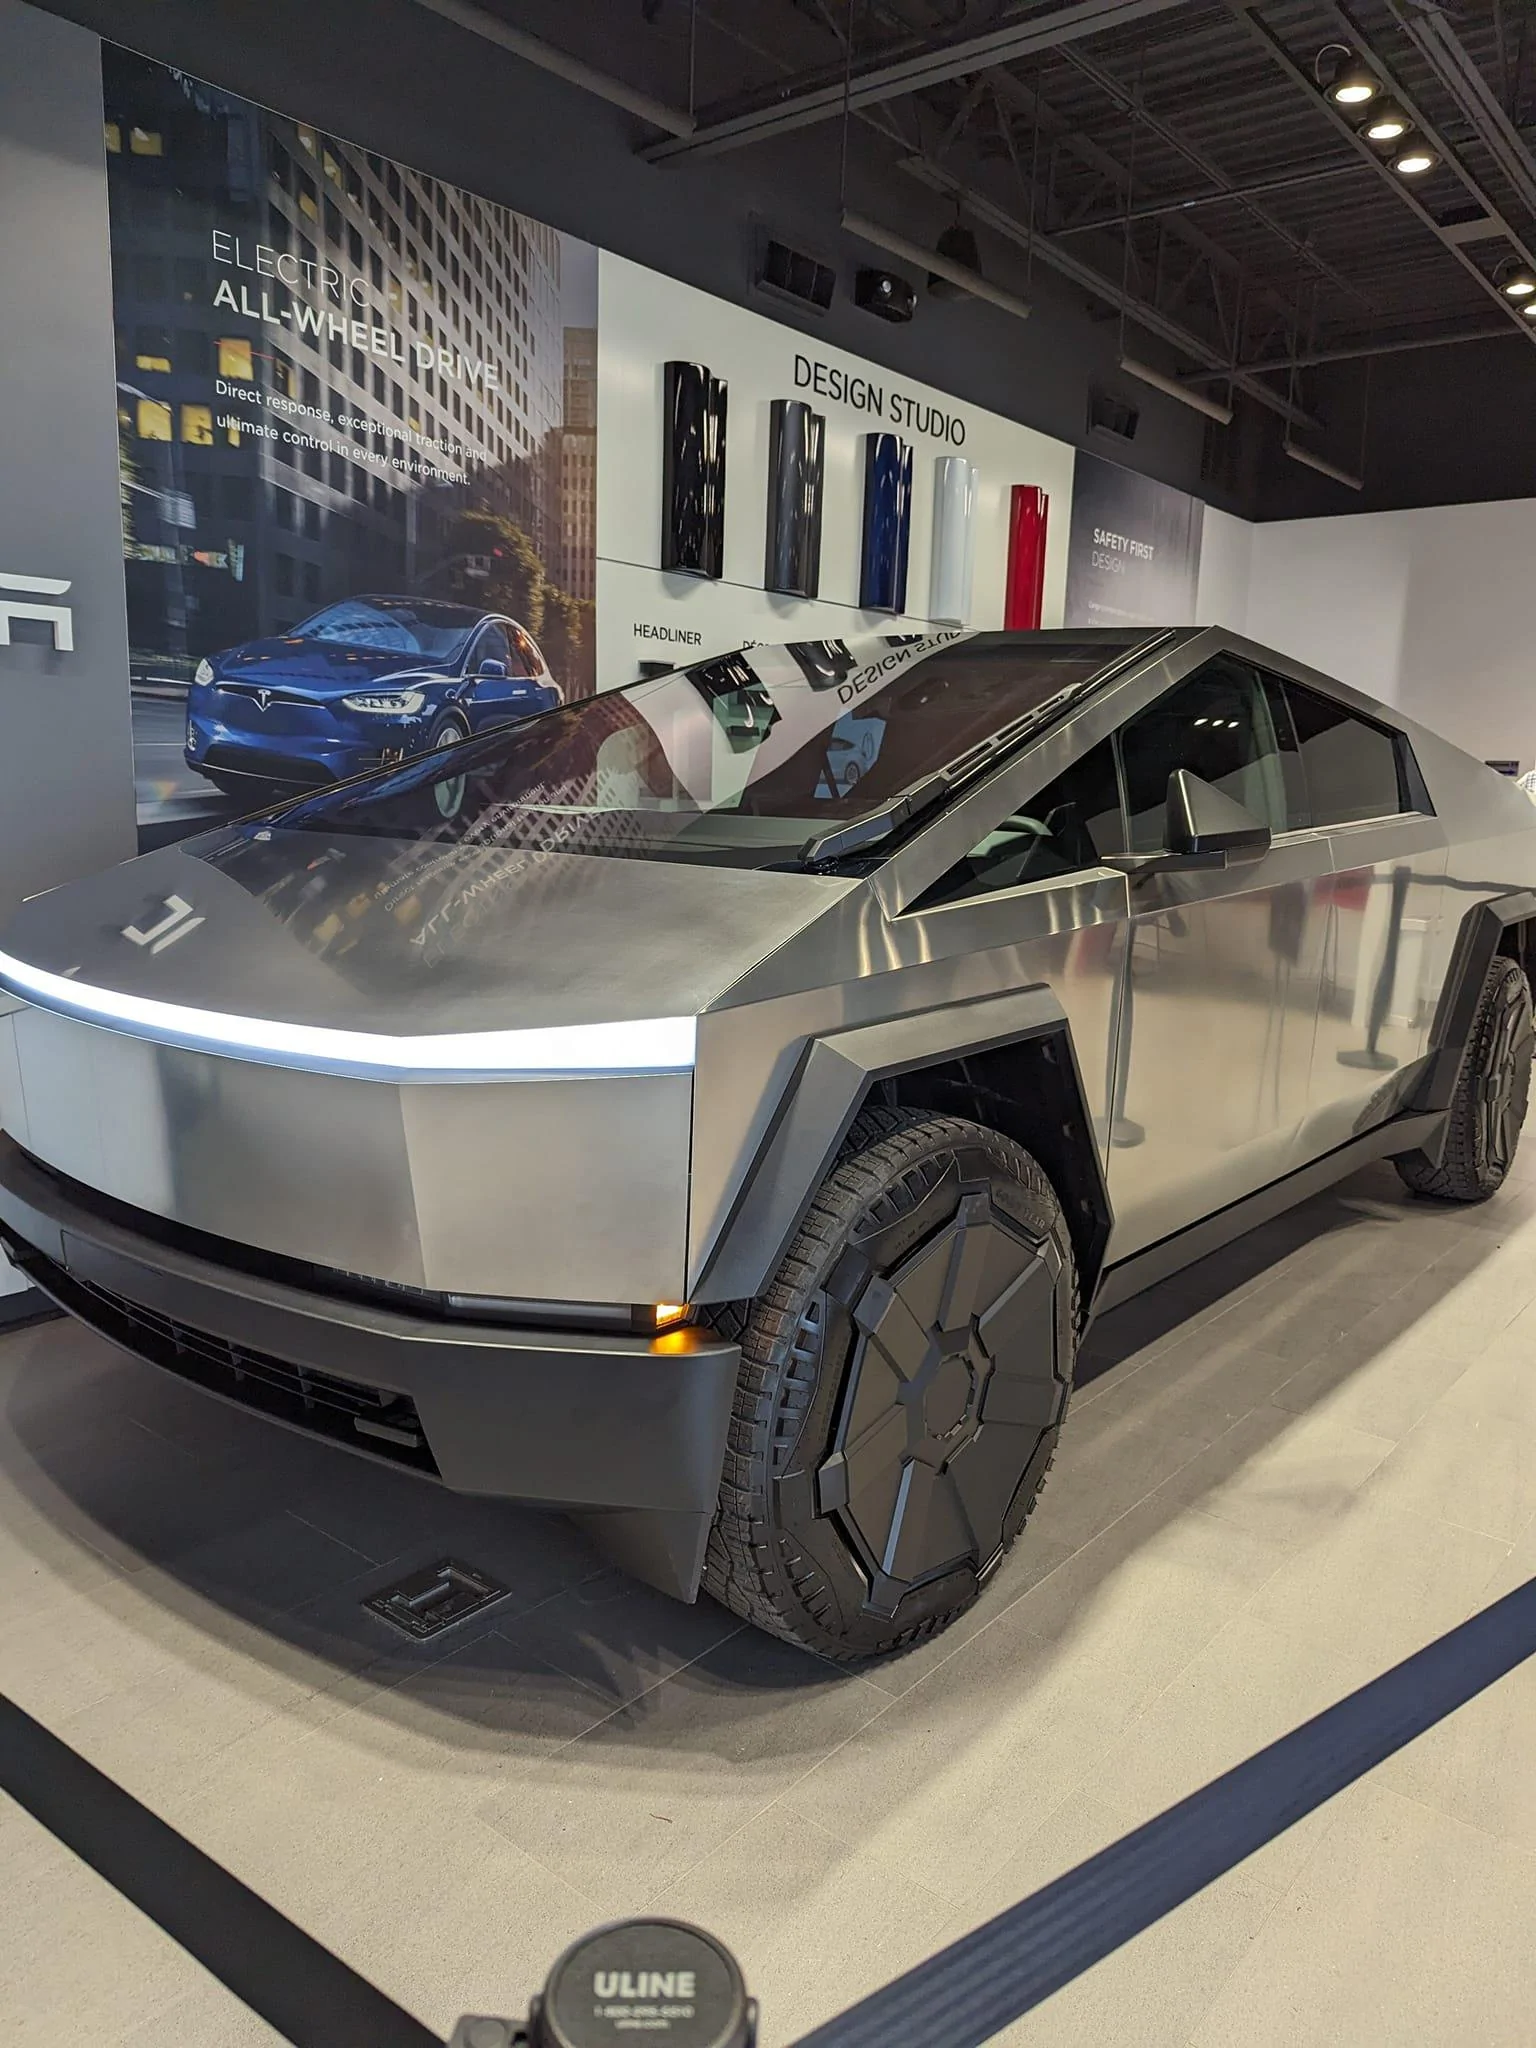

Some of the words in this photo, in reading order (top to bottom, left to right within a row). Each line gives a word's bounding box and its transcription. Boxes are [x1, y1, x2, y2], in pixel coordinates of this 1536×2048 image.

[212, 229, 371, 308] ELECTRIC
[213, 279, 406, 364] ALL-WHEEL
[416, 340, 500, 391] DRIVE
[215, 379, 262, 405] Direct
[266, 395, 334, 425] response,
[337, 414, 412, 442] exceptional
[416, 432, 463, 456] traction
[465, 447, 487, 462] and
[794, 354, 883, 417] DESIGN
[889, 399, 966, 447] STUDIO
[216, 413, 279, 440] ultimate
[282, 431, 333, 453] control
[336, 441, 349, 456] in
[352, 448, 388, 468] every
[391, 457, 471, 486] environment.
[1091, 550, 1126, 576] DESIGN
[1093, 527, 1130, 553] SAFETY
[1129, 540, 1154, 561] FIRST
[633, 622, 702, 646] HEADLINER
[593, 1971, 697, 1998] ULINE
